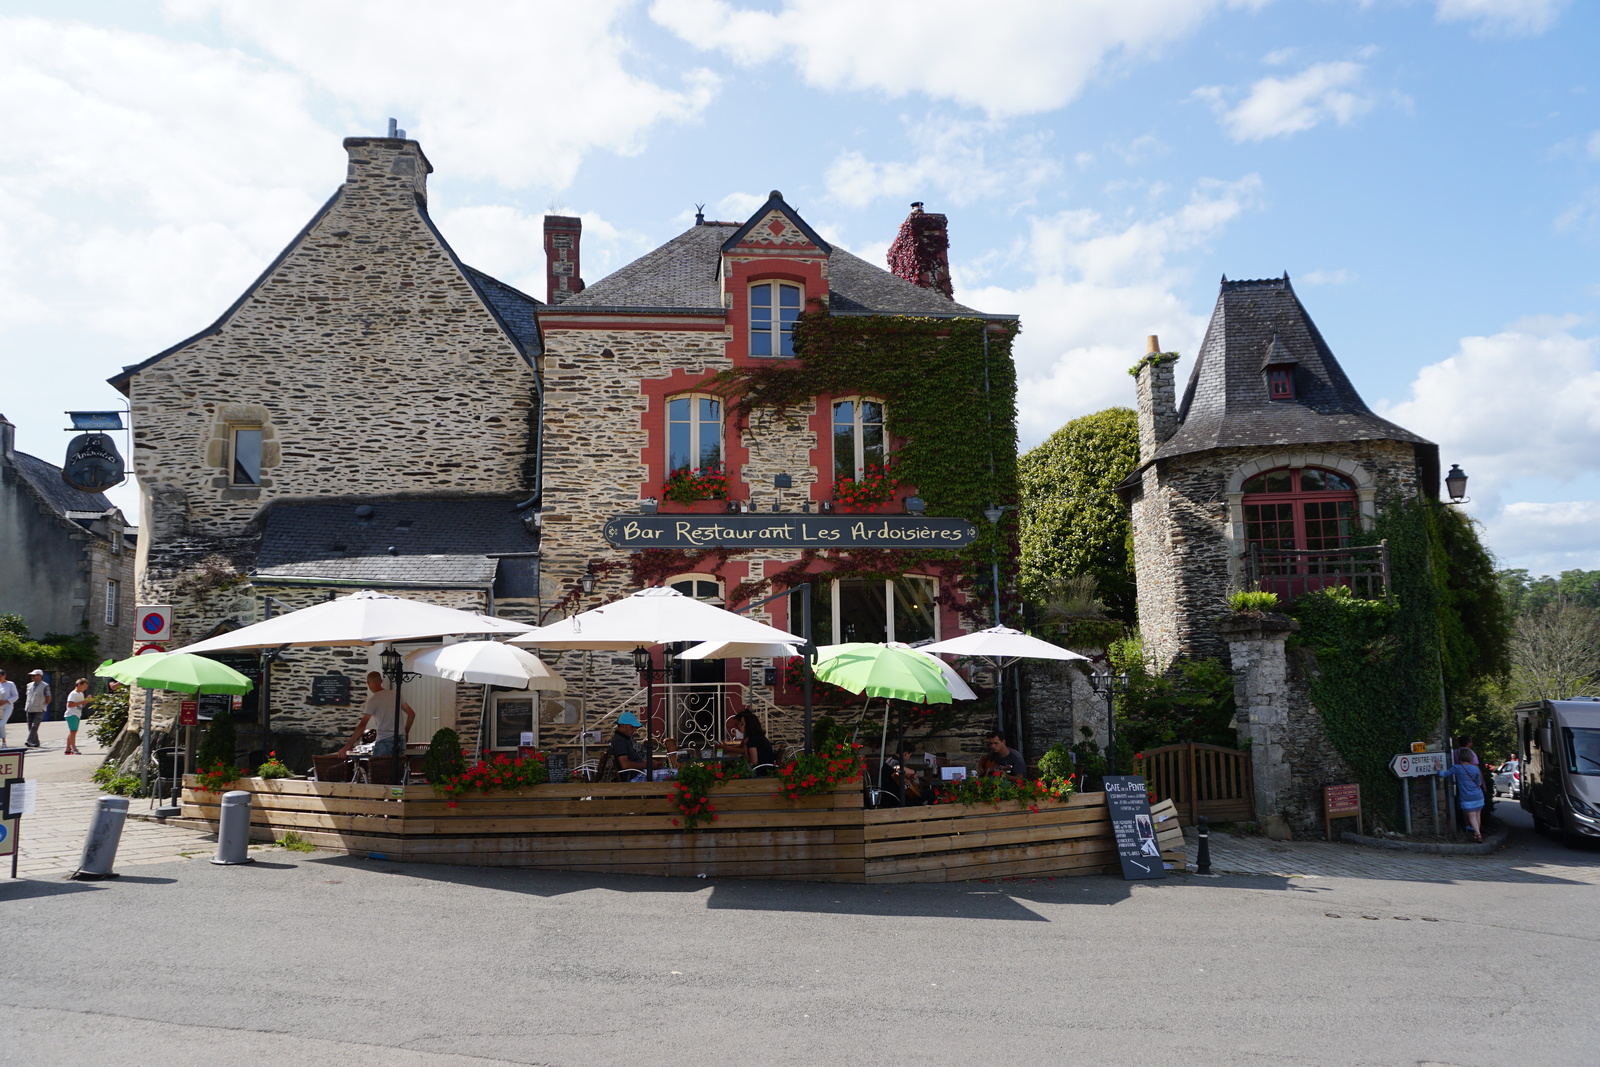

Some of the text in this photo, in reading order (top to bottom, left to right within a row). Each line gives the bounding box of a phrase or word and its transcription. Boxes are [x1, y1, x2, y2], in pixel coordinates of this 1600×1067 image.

[623, 521, 963, 546] Bar Restaurant Les Ardoisières
[1128, 782, 1146, 792] PENTE
